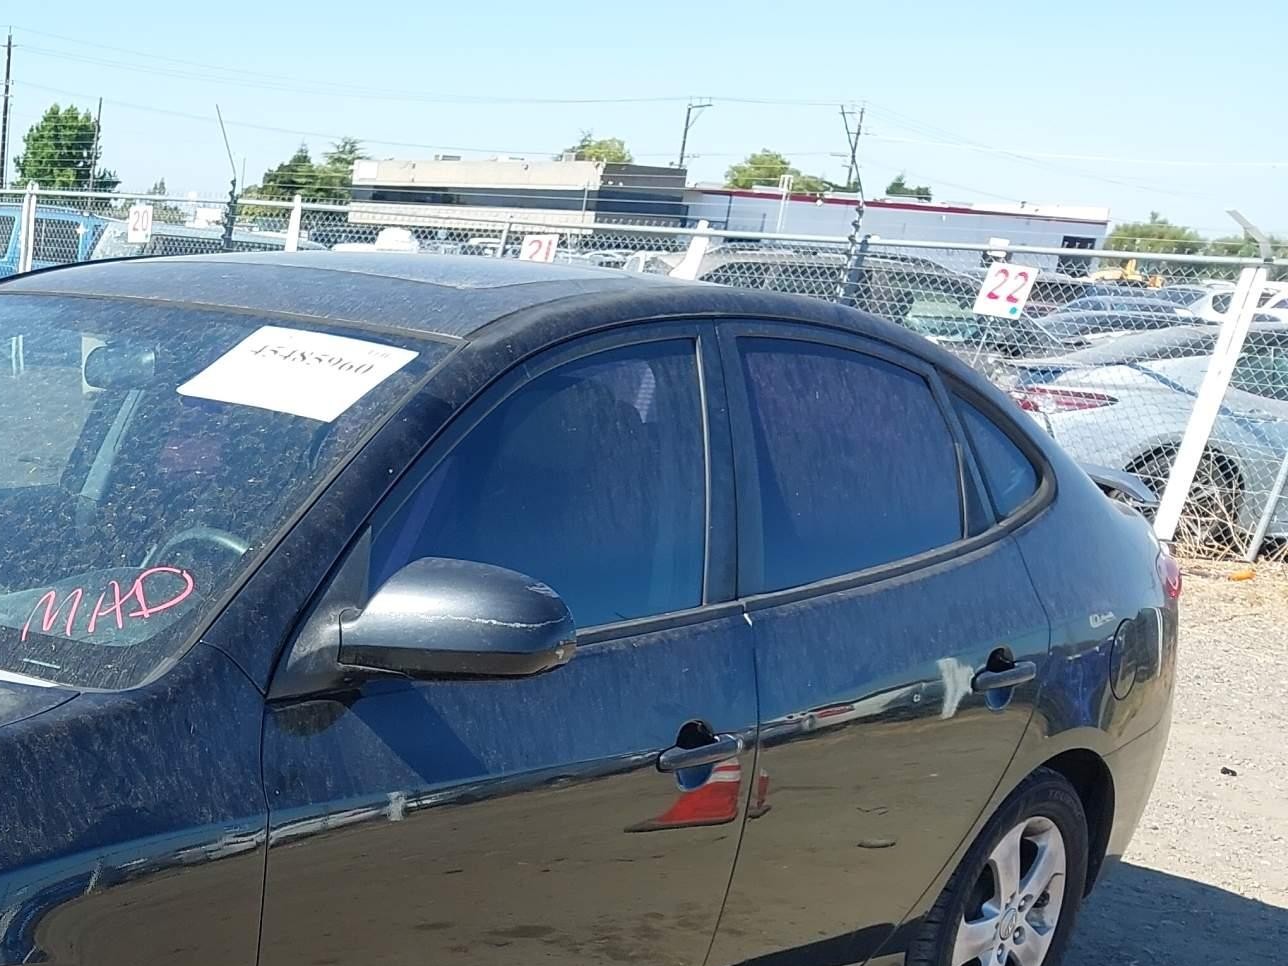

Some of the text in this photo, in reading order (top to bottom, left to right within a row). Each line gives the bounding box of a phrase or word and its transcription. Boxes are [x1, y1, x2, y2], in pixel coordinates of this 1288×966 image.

[132, 209, 149, 231] 20
[528, 239, 553, 261] 21
[987, 268, 1029, 303] 22
[250, 344, 374, 375] 45485960
[21, 566, 195, 641] MAD
